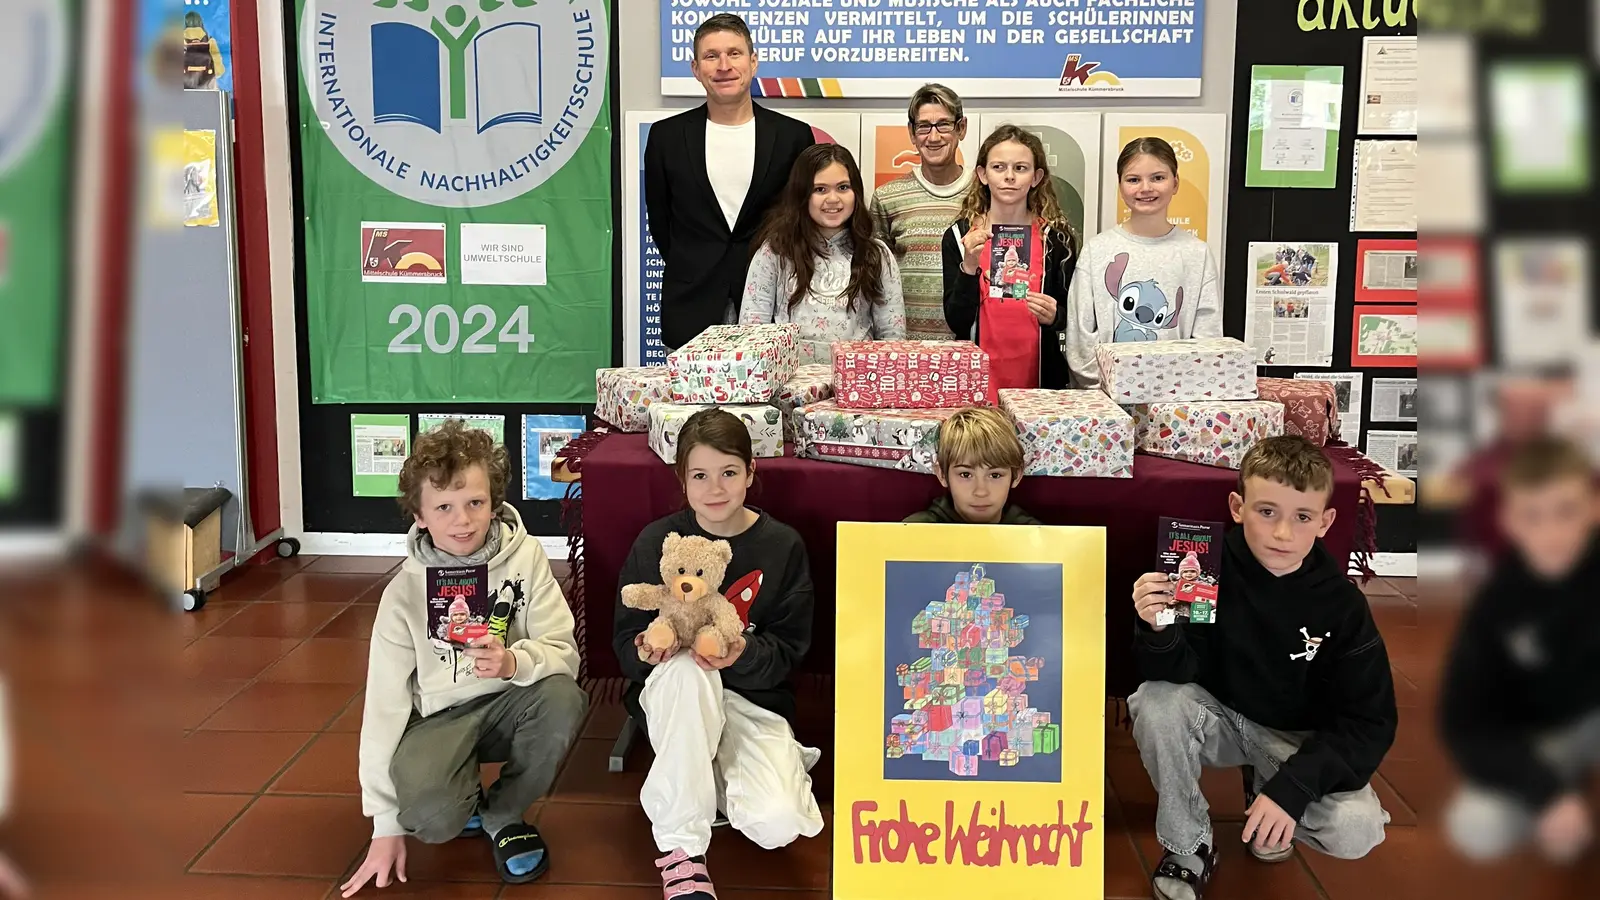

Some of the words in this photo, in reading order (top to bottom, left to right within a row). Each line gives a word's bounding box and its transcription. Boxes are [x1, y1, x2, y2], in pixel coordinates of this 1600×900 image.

[824, 11, 943, 28] VERMITTELT,
[958, 11, 986, 26] UM
[1001, 11, 1033, 26] DIE
[1048, 8, 1194, 26] SCHÜLERINNEN
[814, 29, 852, 44] AUF
[862, 29, 895, 44] IHR
[905, 29, 966, 44] LEBEN
[976, 29, 996, 44] IN
[1007, 29, 1045, 44] DER
[1055, 29, 1194, 44] GESELLSCHAFT
[811, 47, 970, 62] VORZUBEREITEN.
[318, 12, 411, 180] INTERNATIONALE
[420, 9, 595, 192] NACHHALTIGKEITSSCHULE
[375, 230, 388, 238] MS
[481, 244, 499, 252] WIR
[501, 244, 524, 253] SIND
[463, 254, 542, 263] UMWELTSCHULE
[363, 269, 398, 277] Mittelschule
[387, 304, 535, 354] 2024
[1169, 540, 1209, 554] JESUS!
[437, 585, 477, 597] JESUS!
[852, 799, 941, 865] Frohe
[944, 799, 1093, 868] Weihnacht
